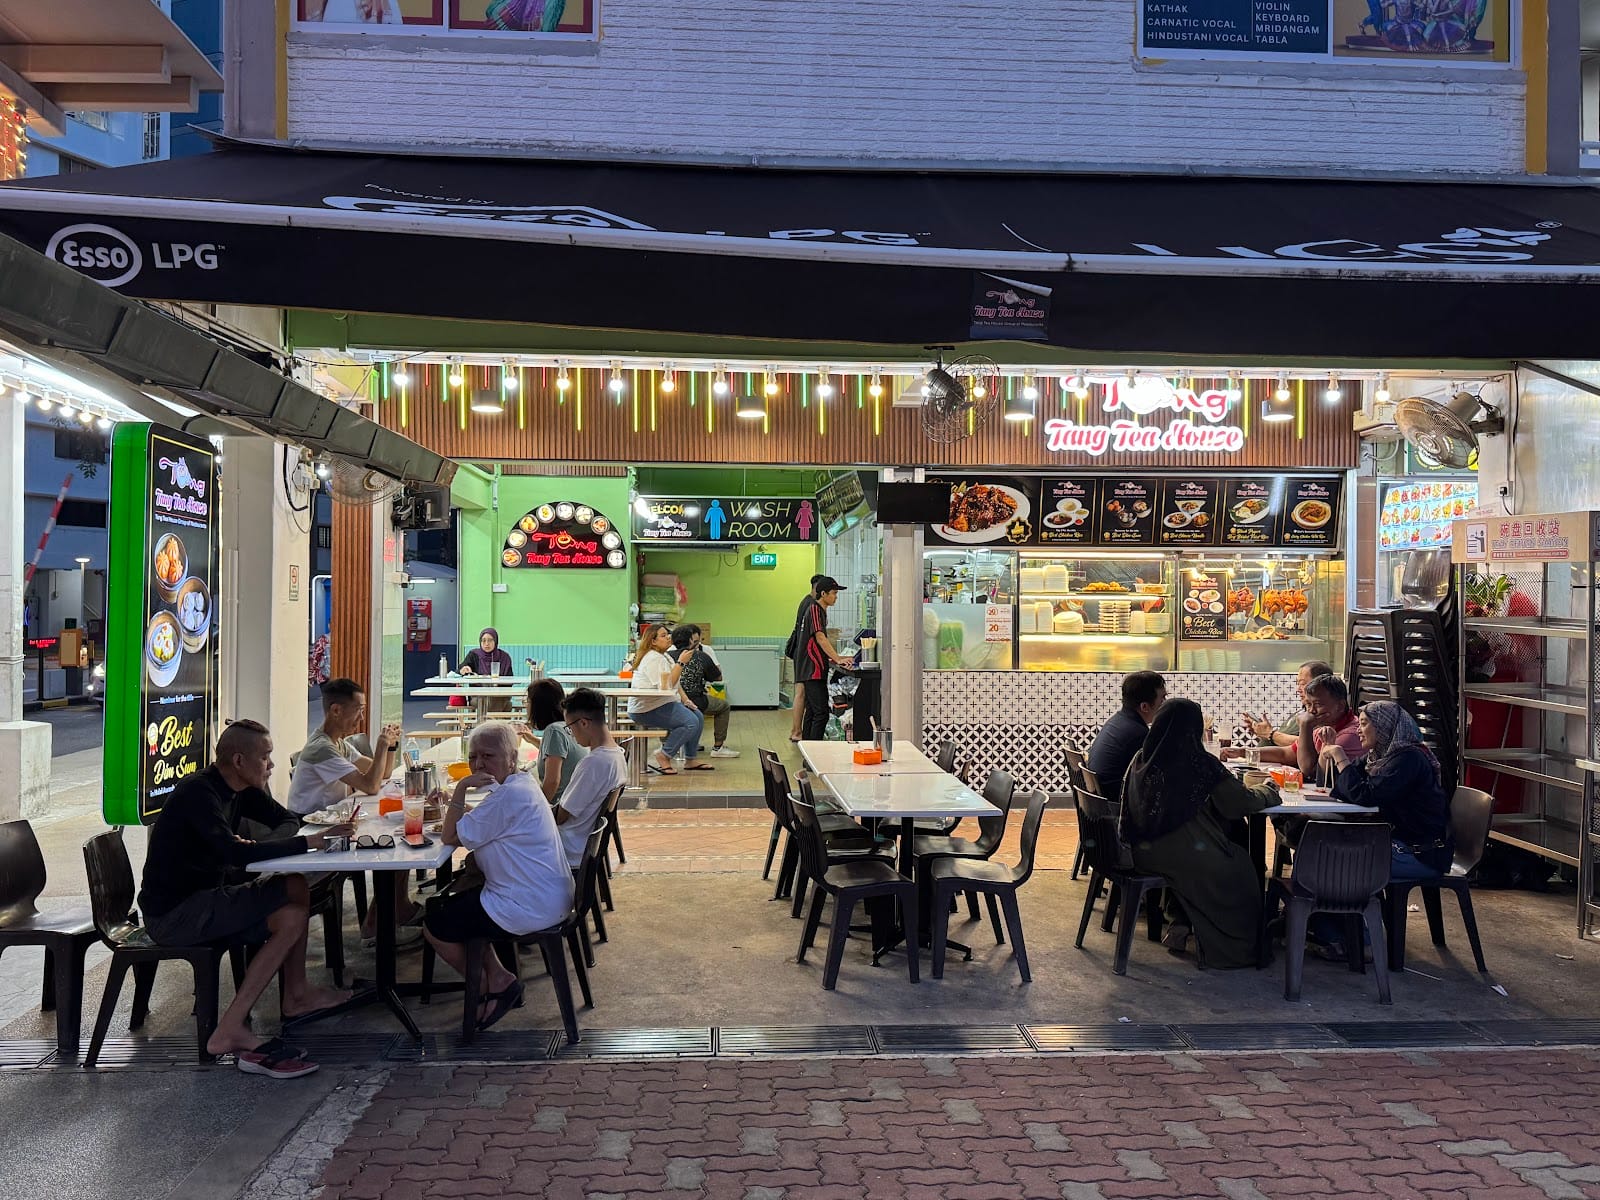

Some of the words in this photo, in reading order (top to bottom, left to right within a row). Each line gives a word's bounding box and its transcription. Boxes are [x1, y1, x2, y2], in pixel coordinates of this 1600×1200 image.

[1147, 4, 1188, 13] KATHAK
[1255, 2, 1290, 11] VIOLIN
[1147, 17, 1199, 27] CARNATIC
[1202, 19, 1237, 28] VOCAL
[1255, 13, 1310, 23] KEYBOARD
[1255, 24, 1320, 34] MRIDANGAM
[1147, 31, 1212, 41] HINDUSTANI
[1215, 33, 1249, 43] VOCAL
[1255, 35, 1288, 44] TABLA
[997, 306, 1015, 317] Tea
[1015, 307, 1045, 318] House
[1046, 419, 1110, 455] Tang
[1112, 420, 1161, 452] Tea
[1162, 420, 1243, 452] House
[730, 501, 791, 518] WASH
[728, 522, 791, 538] ROOM
[754, 555, 770, 563] EXIT
[1193, 616, 1215, 627] Best
[159, 715, 193, 757] Best
[154, 759, 175, 785] Dim
[175, 754, 197, 779] Sum
